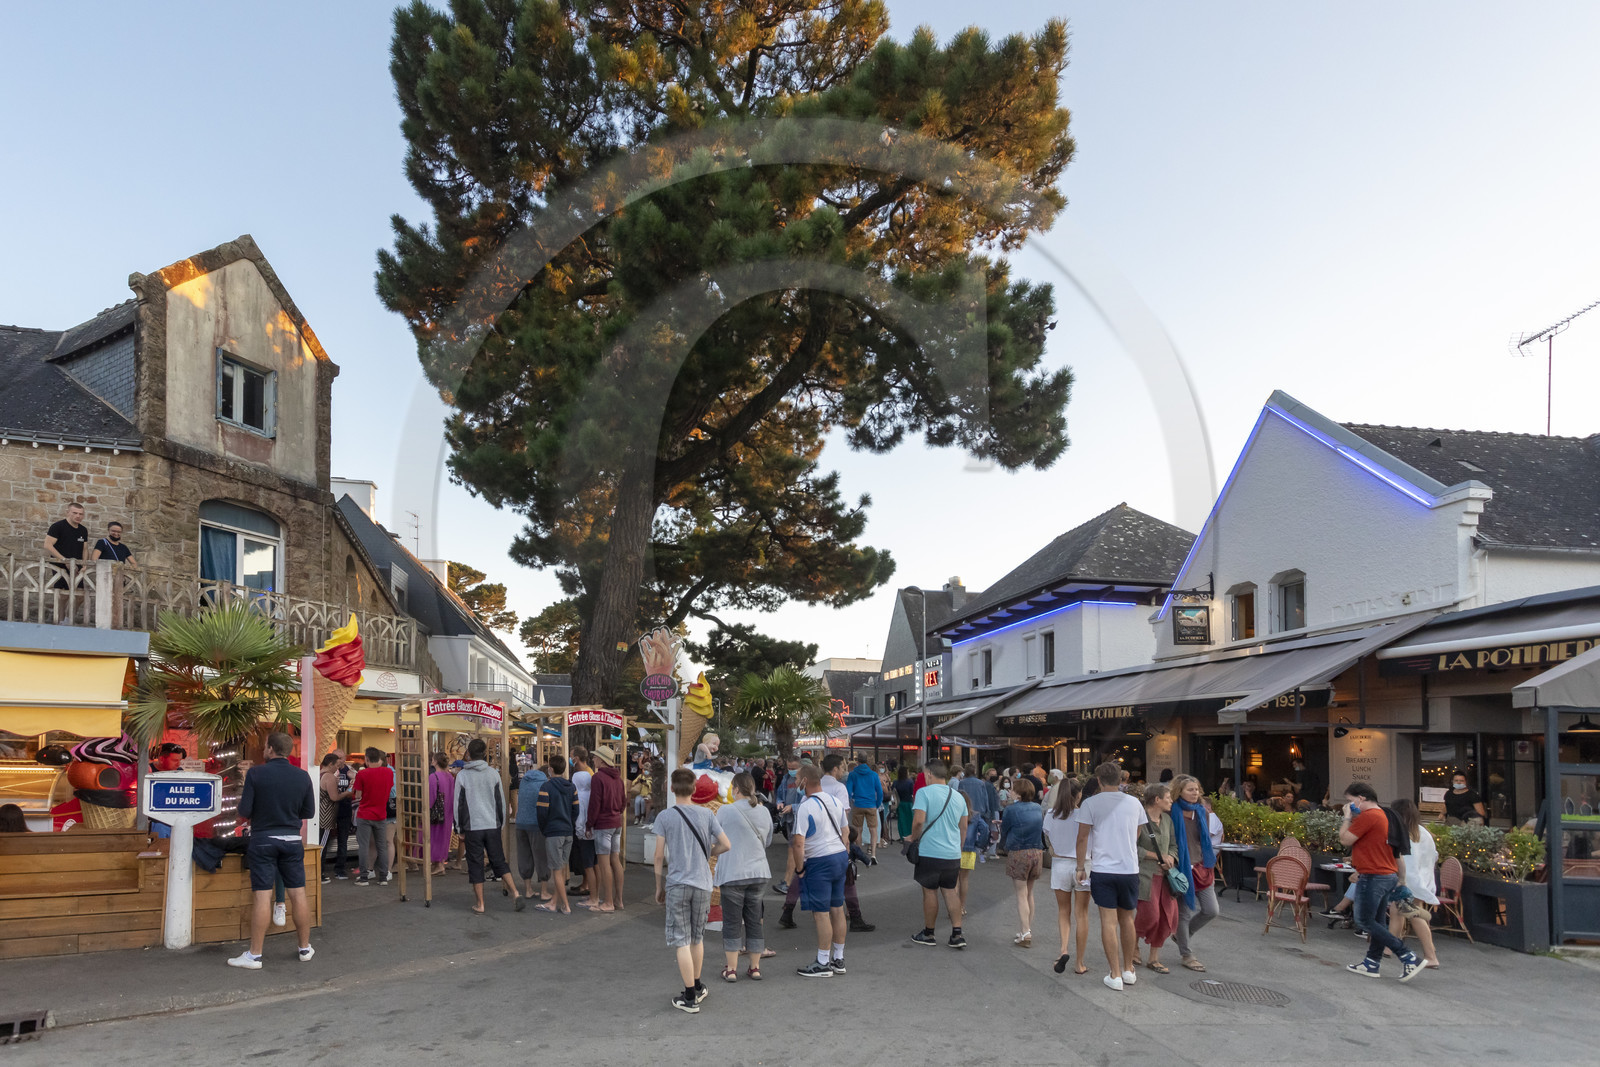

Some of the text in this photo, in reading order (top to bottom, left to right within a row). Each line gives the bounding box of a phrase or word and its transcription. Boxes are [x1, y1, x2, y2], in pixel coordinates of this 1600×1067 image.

[1438, 652, 1472, 670] LA
[646, 675, 671, 686] CHICHIS
[925, 670, 938, 687] REX
[644, 689, 674, 700] CHURROS
[428, 700, 455, 713] Entrée
[457, 700, 472, 712] Glaces
[473, 702, 477, 712] à
[1275, 694, 1306, 708] 1930
[569, 712, 588, 723] Entrée
[1019, 714, 1048, 724] BRASSERIE
[1082, 710, 1092, 720] LA
